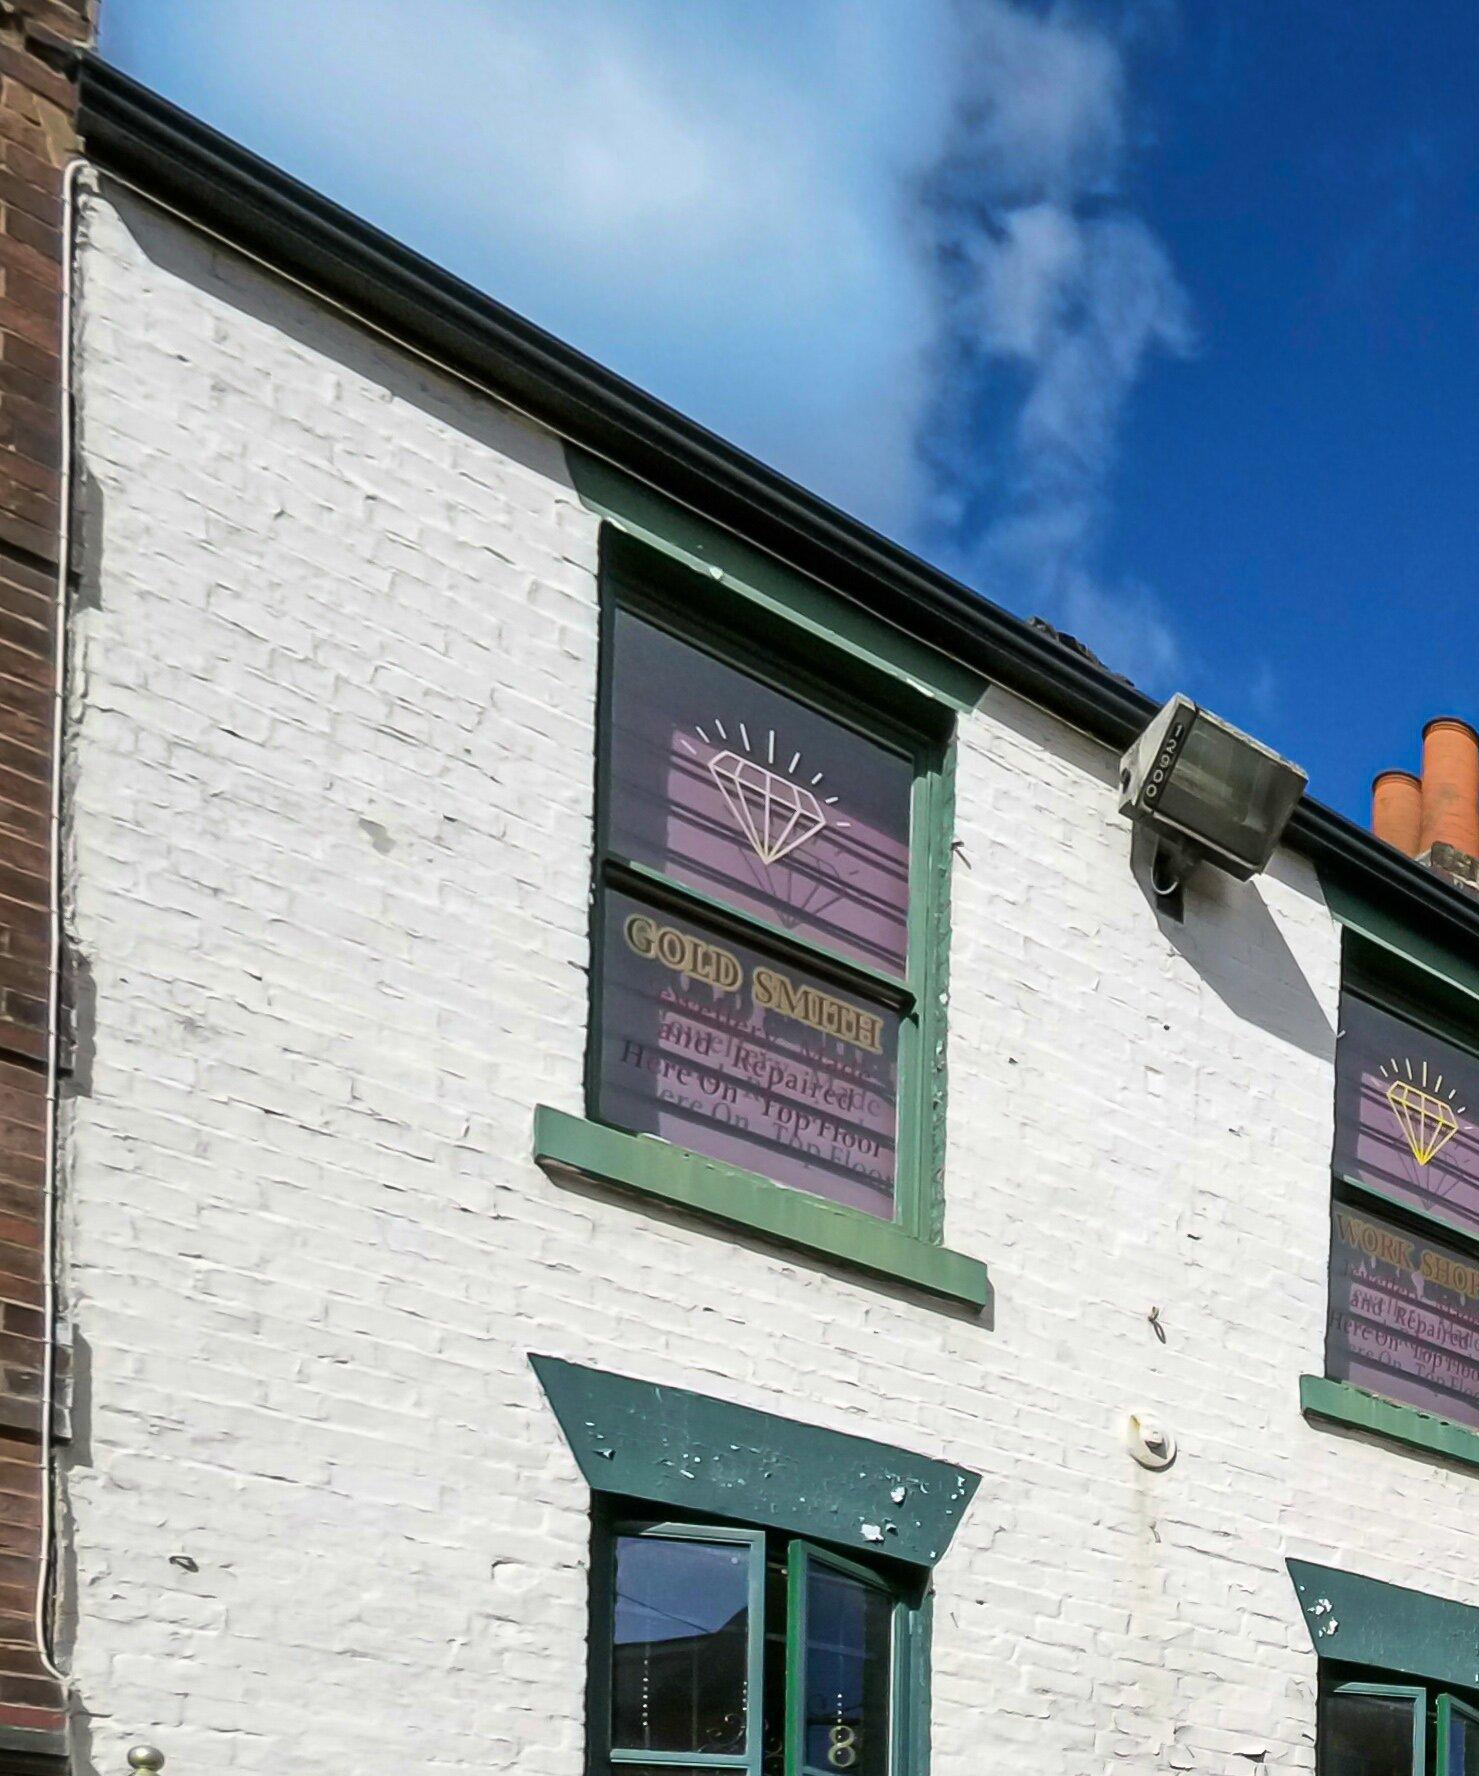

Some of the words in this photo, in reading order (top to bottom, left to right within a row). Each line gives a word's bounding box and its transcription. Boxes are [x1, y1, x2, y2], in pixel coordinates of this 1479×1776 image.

[625, 913, 743, 992] GOLD
[753, 966, 884, 1056] SMITH
[1335, 1213, 1415, 1271] WORK
